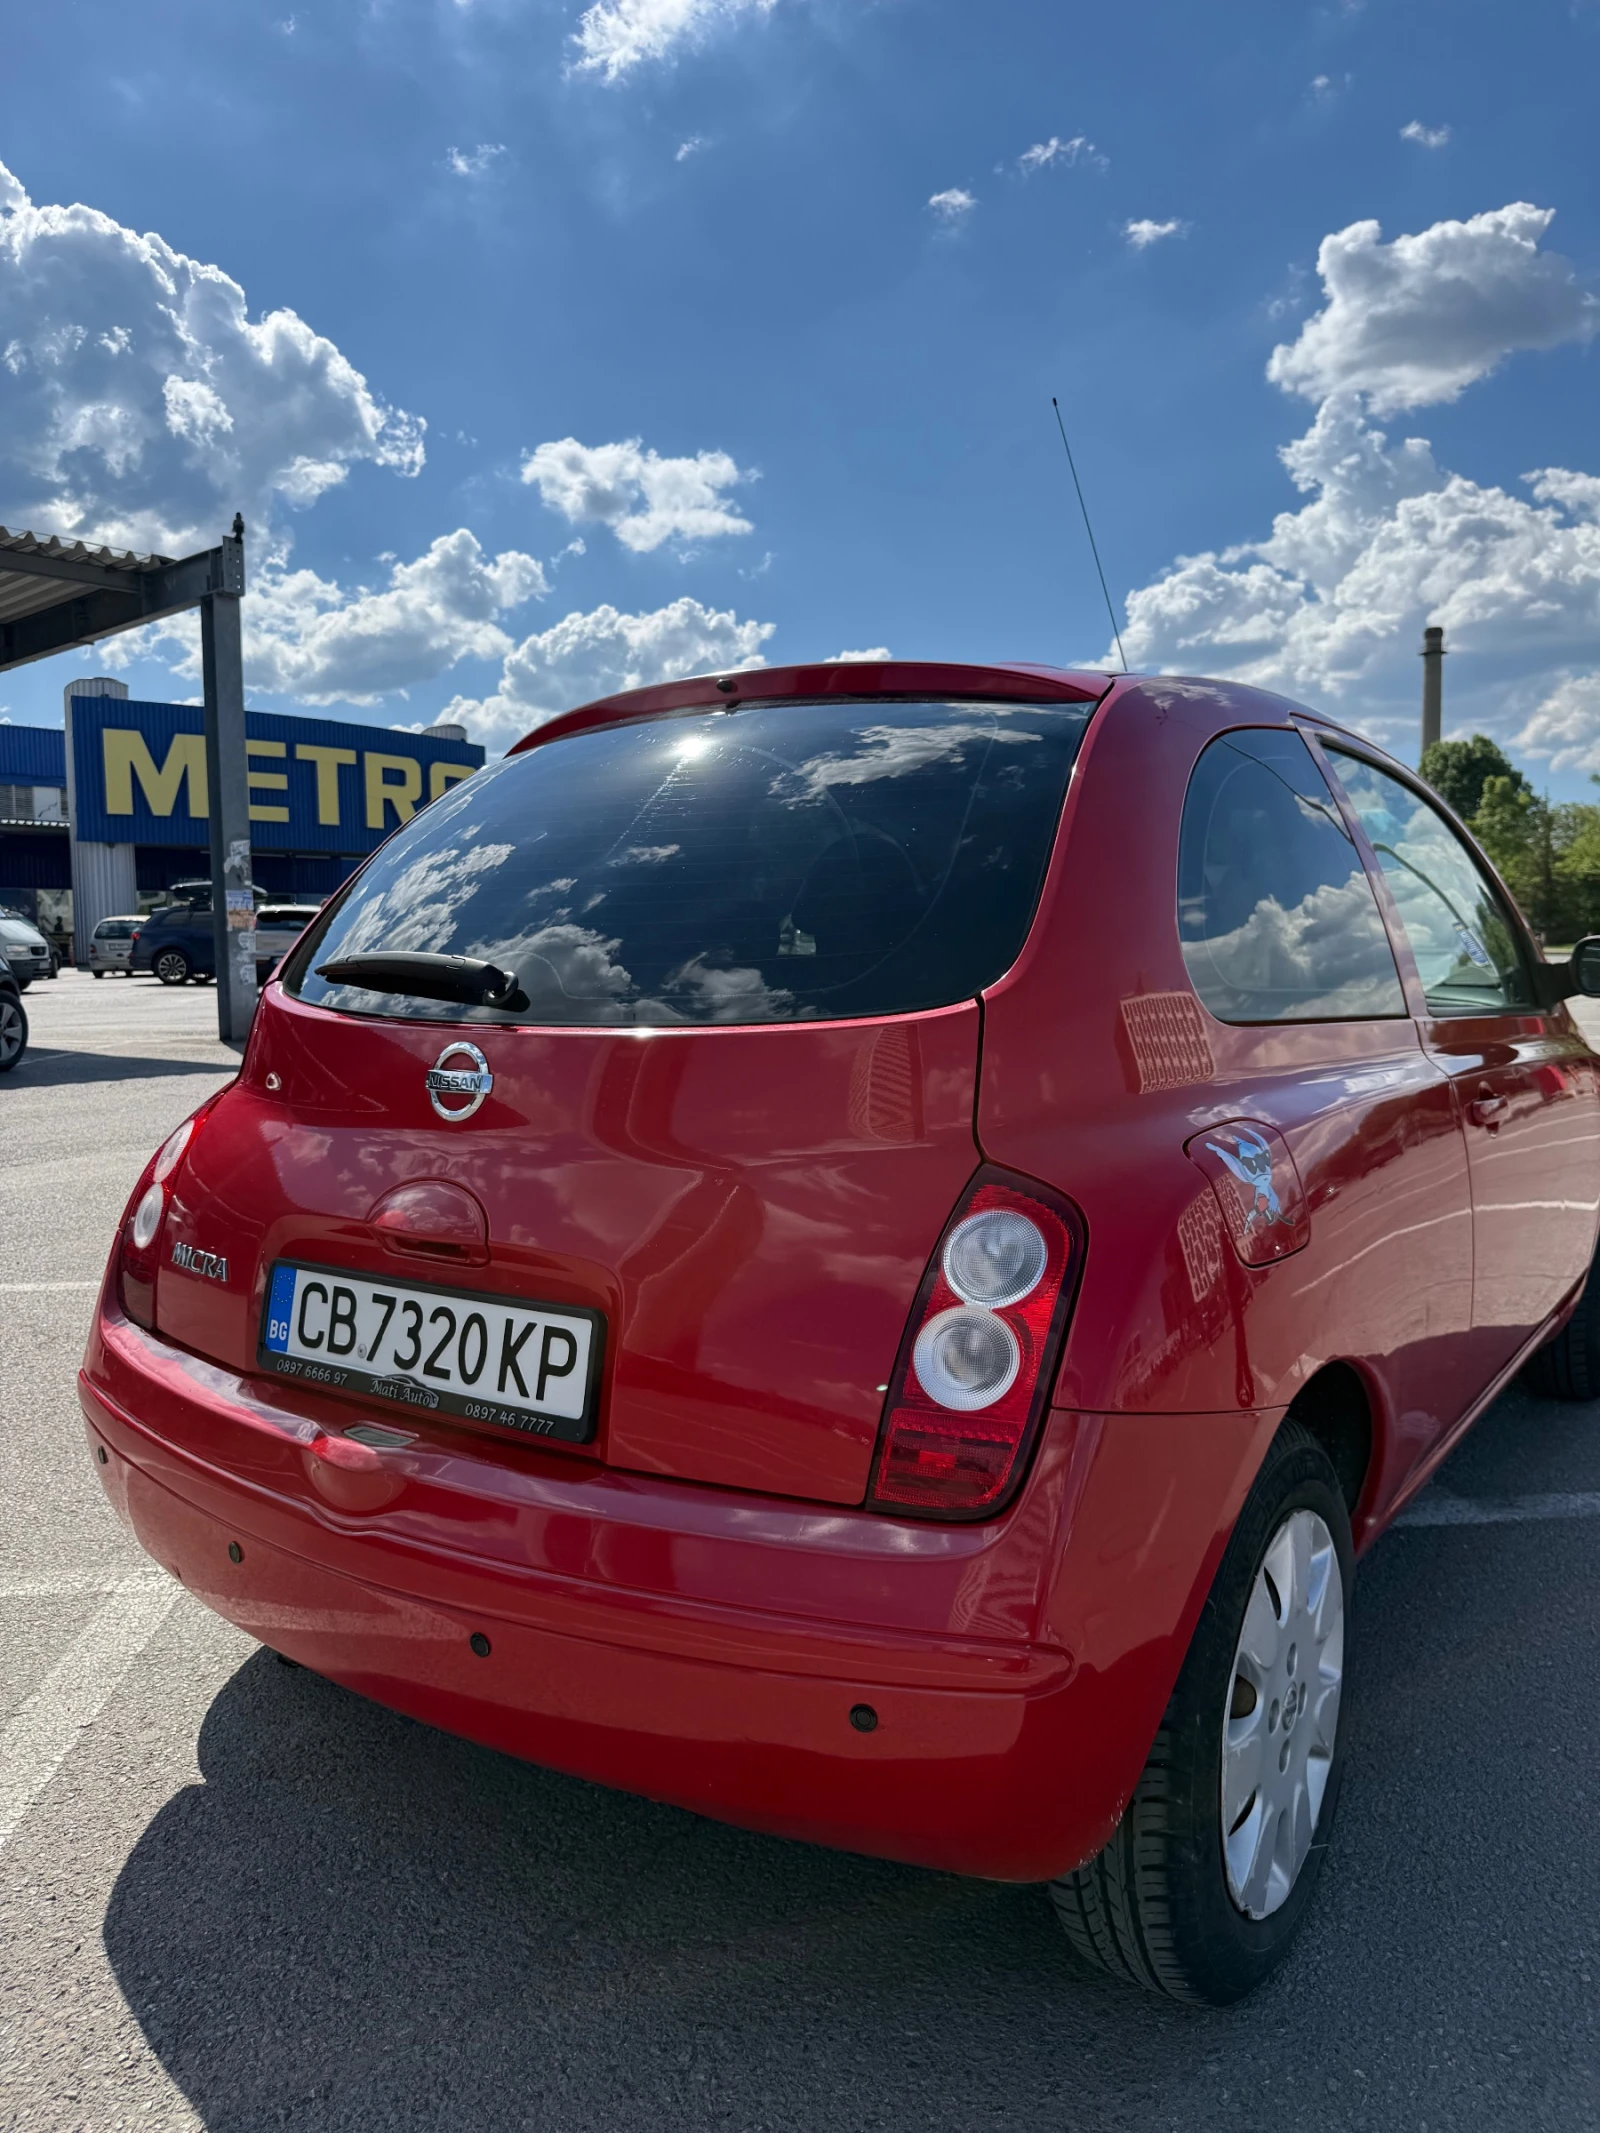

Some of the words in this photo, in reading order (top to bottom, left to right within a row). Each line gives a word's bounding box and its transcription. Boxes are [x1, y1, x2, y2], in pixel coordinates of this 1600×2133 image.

[427, 1073, 482, 1091] NISSAN
[171, 1242, 227, 1282] MICRA
[269, 1319, 288, 1341] BG
[297, 1281, 358, 1355] CB
[366, 1293, 489, 1386] 7320
[497, 1317, 578, 1401] KP
[276, 1358, 303, 1375] 0897
[304, 1365, 331, 1382] 6666
[333, 1371, 348, 1386] 97
[370, 1380, 399, 1399] Mati
[400, 1387, 430, 1406] Auto
[465, 1402, 497, 1421] 0897
[500, 1410, 516, 1426] 46
[520, 1415, 554, 1435] 7777
